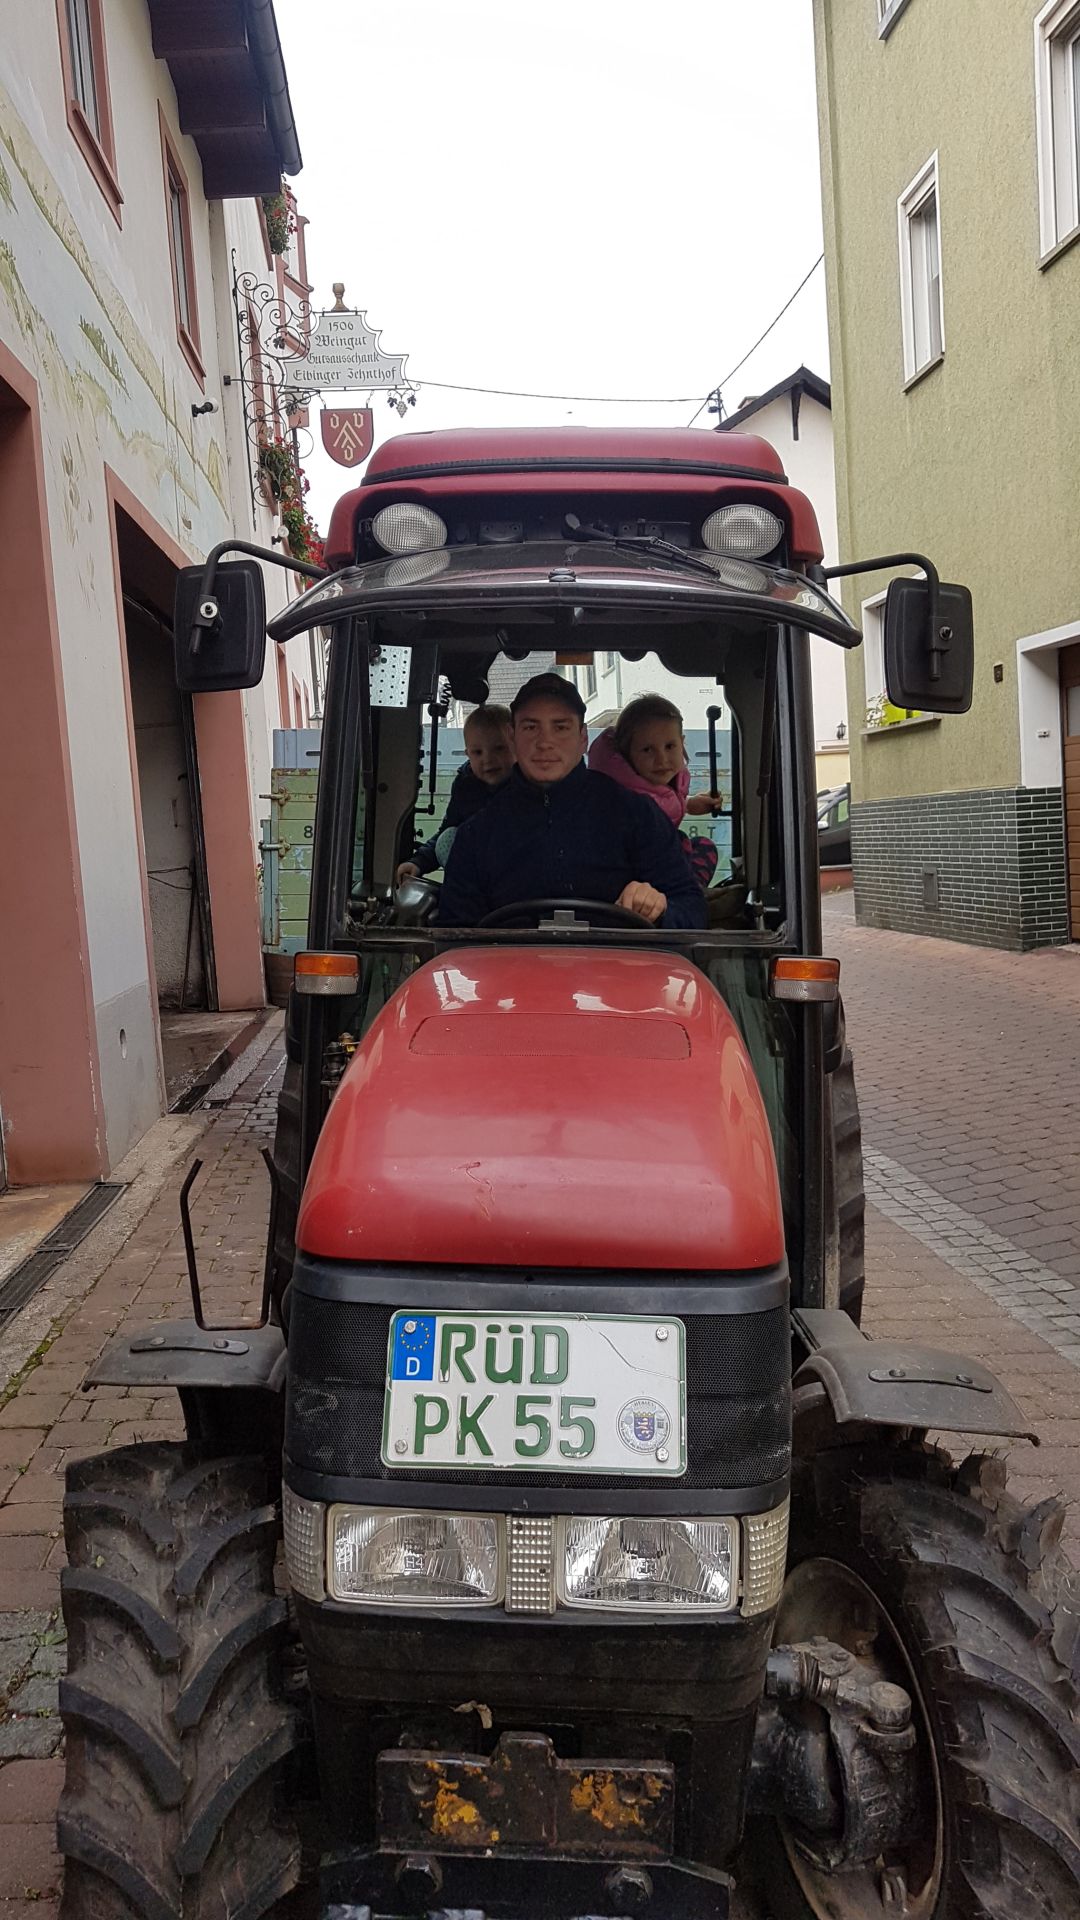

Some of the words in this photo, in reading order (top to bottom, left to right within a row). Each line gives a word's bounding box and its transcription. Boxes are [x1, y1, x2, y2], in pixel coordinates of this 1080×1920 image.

[328, 321, 354, 332] 1506
[315, 335, 367, 350] Weingut
[307, 353, 379, 365] Gutsausschank
[293, 369, 341, 384] Eibinger
[347, 368, 397, 383] Zehnthof
[303, 825, 313, 838] 8
[405, 1357, 420, 1376] D
[413, 1394, 495, 1456] PK
[514, 1394, 596, 1458] 55
[405, 1557, 423, 1568] H4
